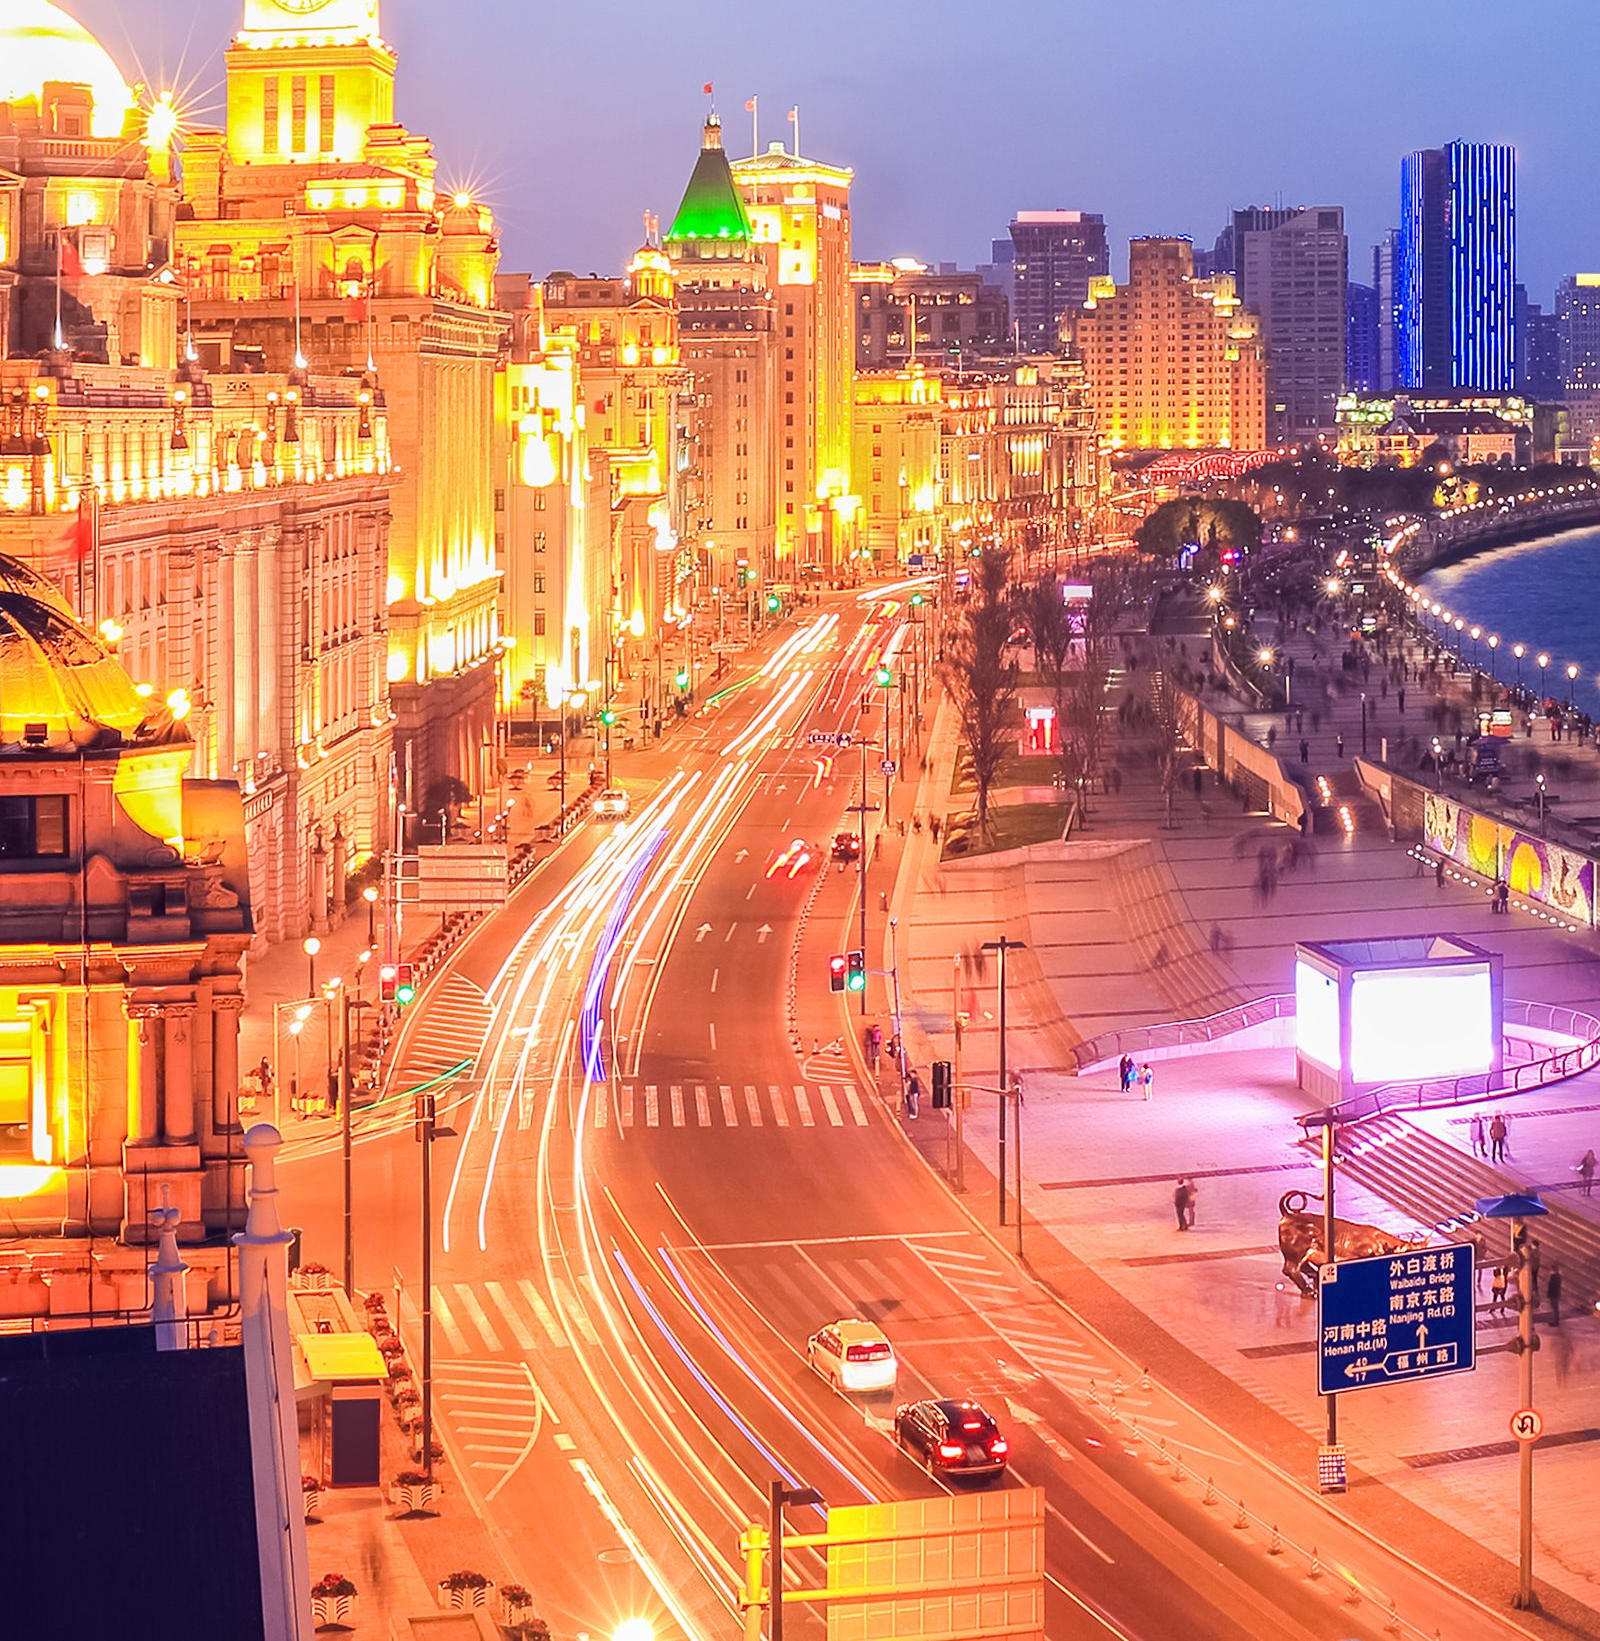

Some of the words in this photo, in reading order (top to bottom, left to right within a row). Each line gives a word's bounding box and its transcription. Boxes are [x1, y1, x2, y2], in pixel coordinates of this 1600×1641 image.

[1390, 1252, 1455, 1277] 外白渡桥
[1390, 1277, 1426, 1290] Waibaidu
[1429, 1273, 1455, 1285] Bridge
[1389, 1286, 1455, 1311] 南京东路
[1389, 1311, 1424, 1324] Nanjing
[1427, 1305, 1455, 1318] Rd.(E)
[1324, 1318, 1387, 1343] 河南中路
[1324, 1344, 1355, 1357] Henan
[1357, 1337, 1388, 1352] Rd.(M)
[1356, 1357, 1368, 1366] 40
[1397, 1349, 1449, 1369] 福州路
[1355, 1372, 1367, 1382] 17
